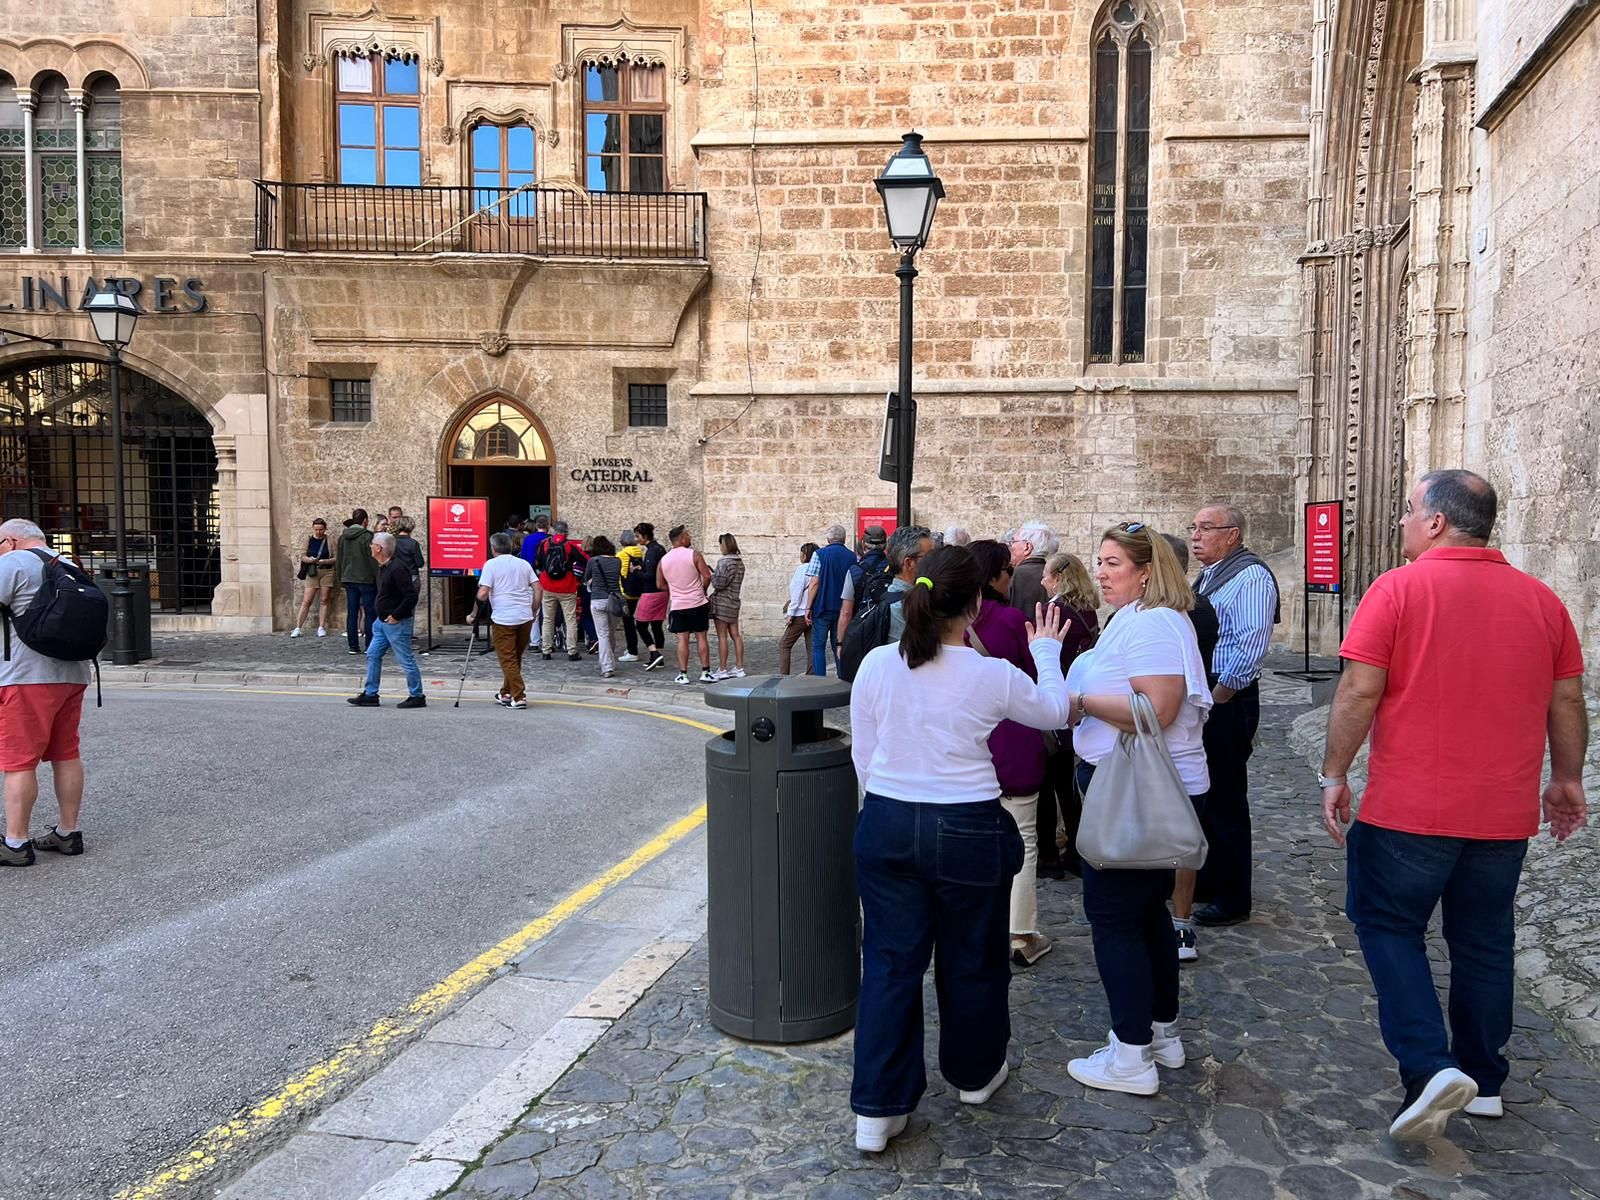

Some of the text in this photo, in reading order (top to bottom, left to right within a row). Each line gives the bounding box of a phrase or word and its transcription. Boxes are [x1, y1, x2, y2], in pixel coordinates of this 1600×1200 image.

[0, 276, 208, 312] INARES
[592, 458, 633, 467] MVSEVS
[571, 469, 653, 482] CATEDRAL
[586, 483, 638, 493] CLAVSTRE
